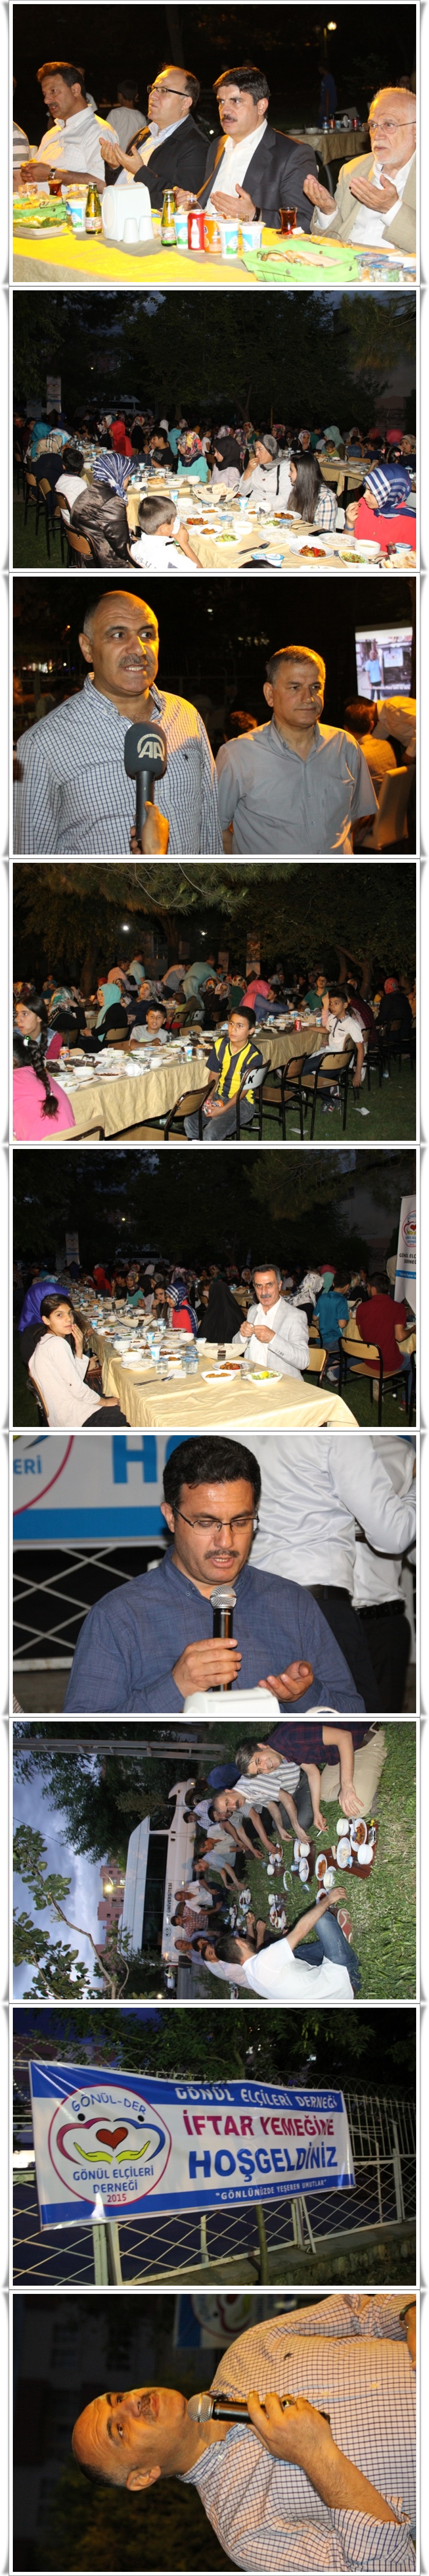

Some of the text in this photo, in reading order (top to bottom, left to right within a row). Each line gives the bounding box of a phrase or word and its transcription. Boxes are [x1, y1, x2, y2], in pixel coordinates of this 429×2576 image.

[138, 741, 164, 761] AA
[72, 2092, 146, 2114] GÖNÜL-DER
[175, 2086, 337, 2108] GÖNÜL ELÇİLERİ DERNEĞİ
[183, 2109, 334, 2136] İFTAR YEMEĞİNE
[188, 2141, 338, 2182] HOŞGELDİNİZ
[73, 2165, 154, 2181] GÖNÜL ELÇİLERİ
[93, 2179, 138, 2194] DERNEĞİ
[276, 2184, 300, 2193] YEŞEREN
[107, 2194, 126, 2202] 2015
